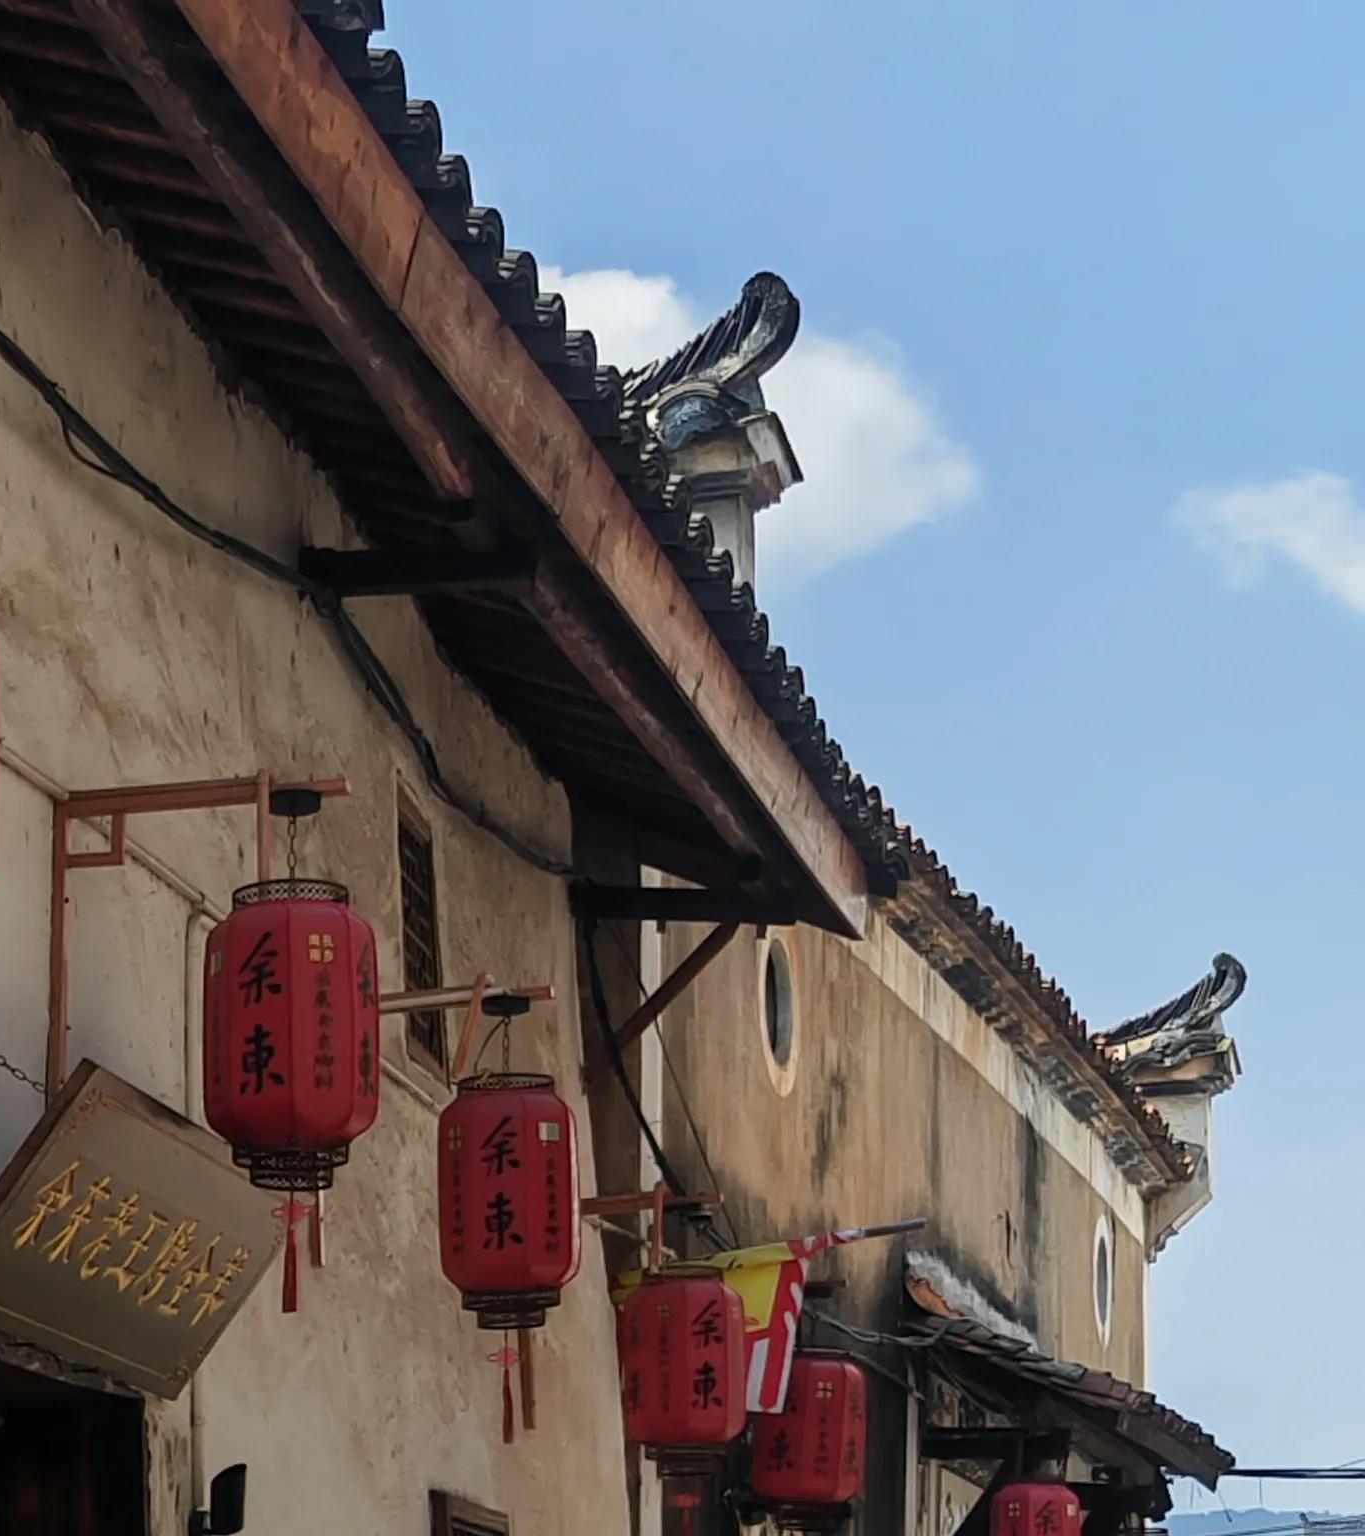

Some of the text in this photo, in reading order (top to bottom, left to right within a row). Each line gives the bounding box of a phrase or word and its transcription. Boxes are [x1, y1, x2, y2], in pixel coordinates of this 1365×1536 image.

[238, 931, 285, 1095] 余東
[480, 1116, 525, 1249] 余東
[691, 1300, 724, 1411] 余東
